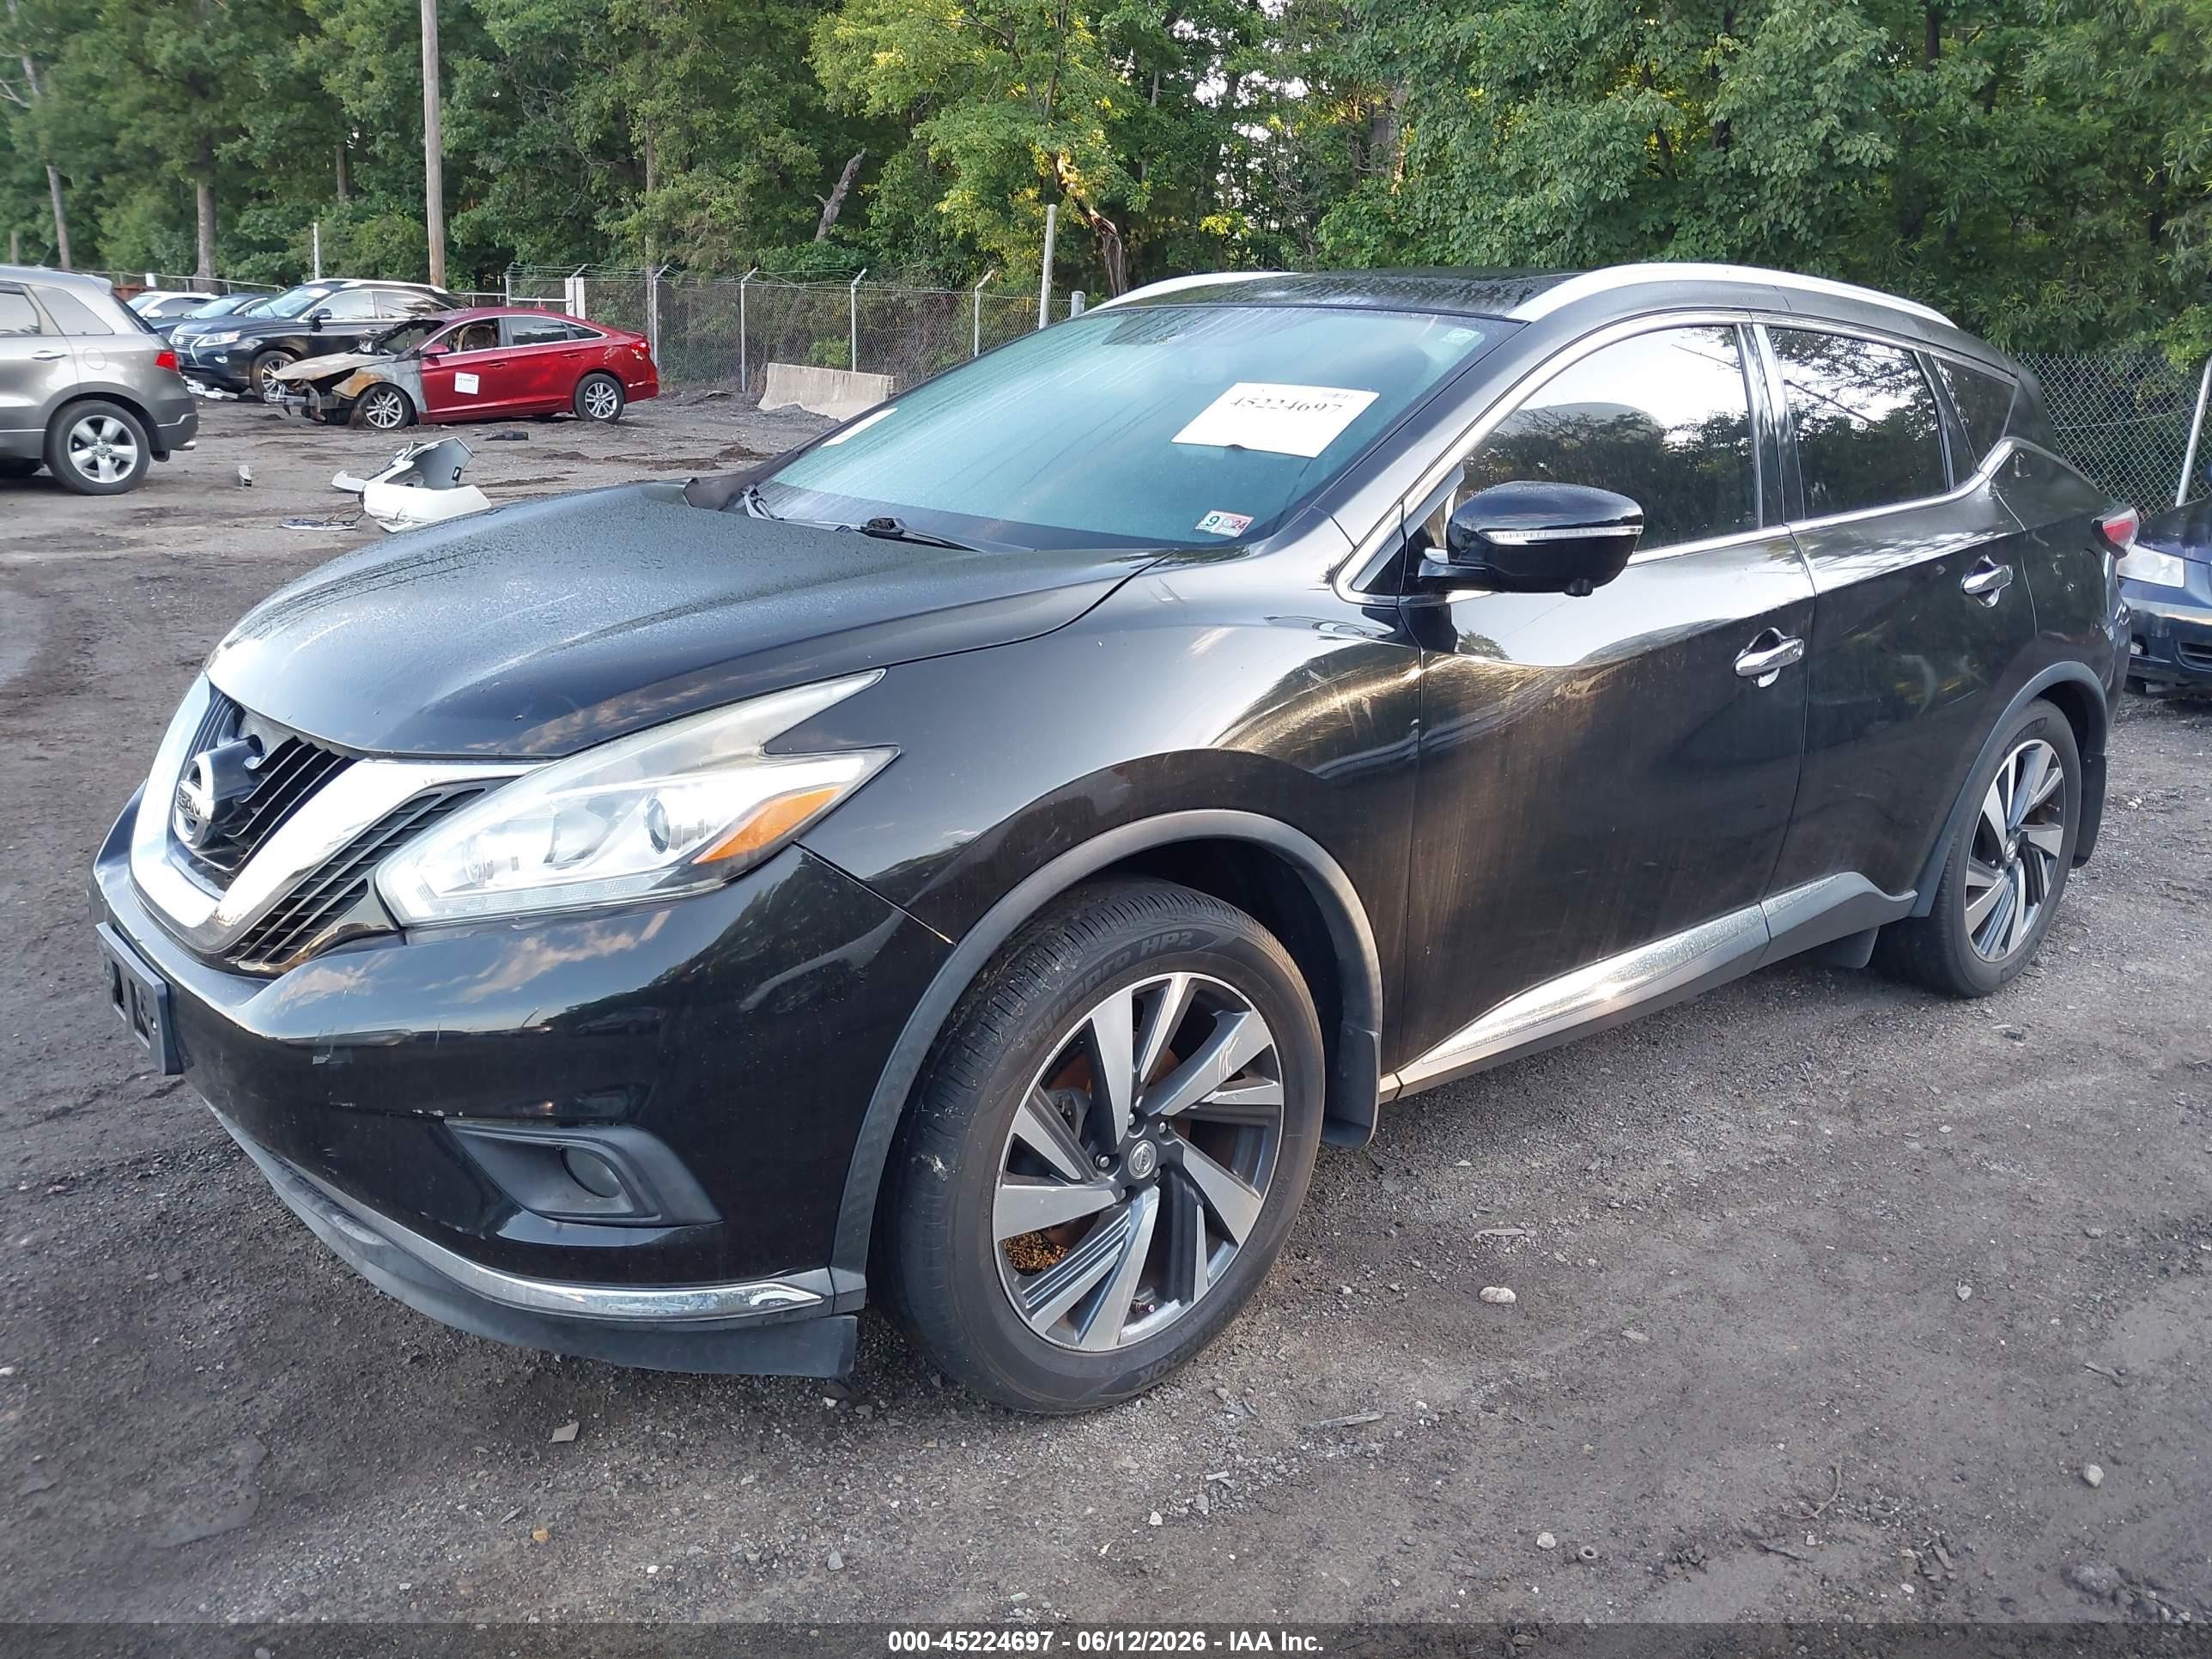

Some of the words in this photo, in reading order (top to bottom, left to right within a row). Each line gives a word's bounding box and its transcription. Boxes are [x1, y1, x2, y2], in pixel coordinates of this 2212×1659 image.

[1230, 397, 1343, 415] 45224697
[1206, 515, 1220, 527] 9
[1231, 520, 1249, 531] 24
[1139, 931, 1194, 957] HP2
